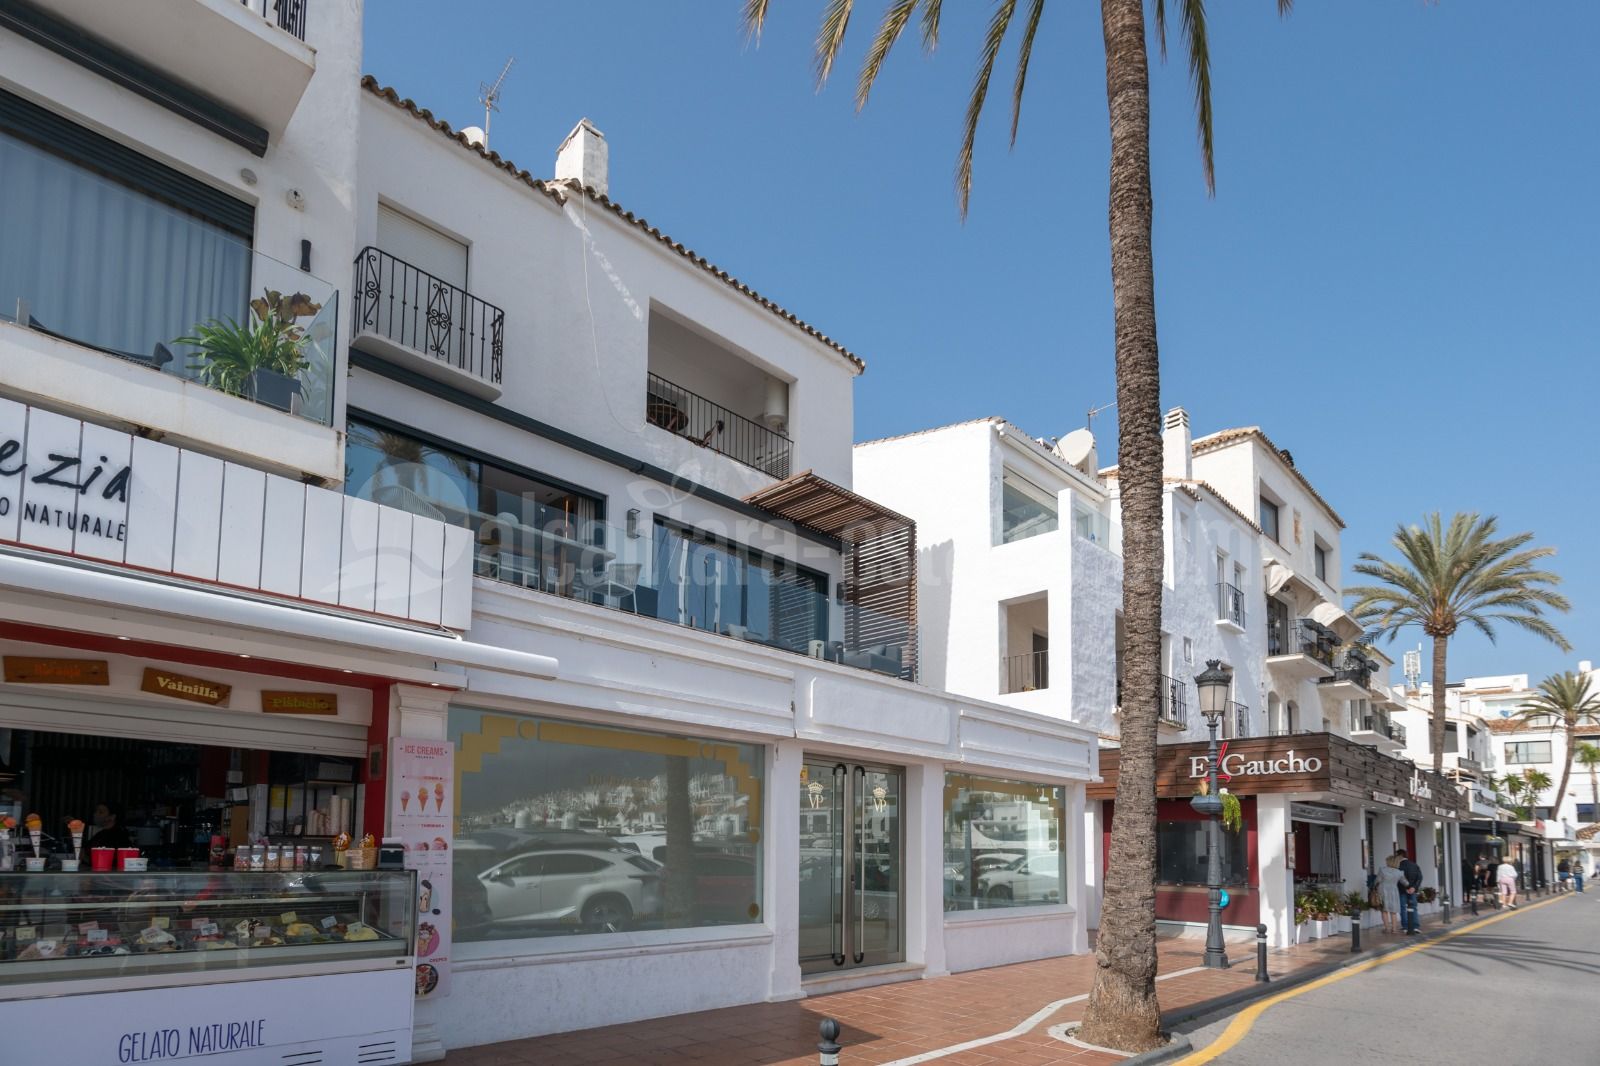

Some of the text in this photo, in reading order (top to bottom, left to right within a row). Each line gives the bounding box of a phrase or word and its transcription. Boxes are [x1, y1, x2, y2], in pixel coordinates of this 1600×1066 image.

[24, 503, 127, 542] NATURALE
[156, 676, 219, 700] Vainilla
[404, 745, 445, 757] ICE CREAMS
[1221, 749, 1322, 777] Gaucho
[118, 1019, 266, 1063] GELATO NATURALE
